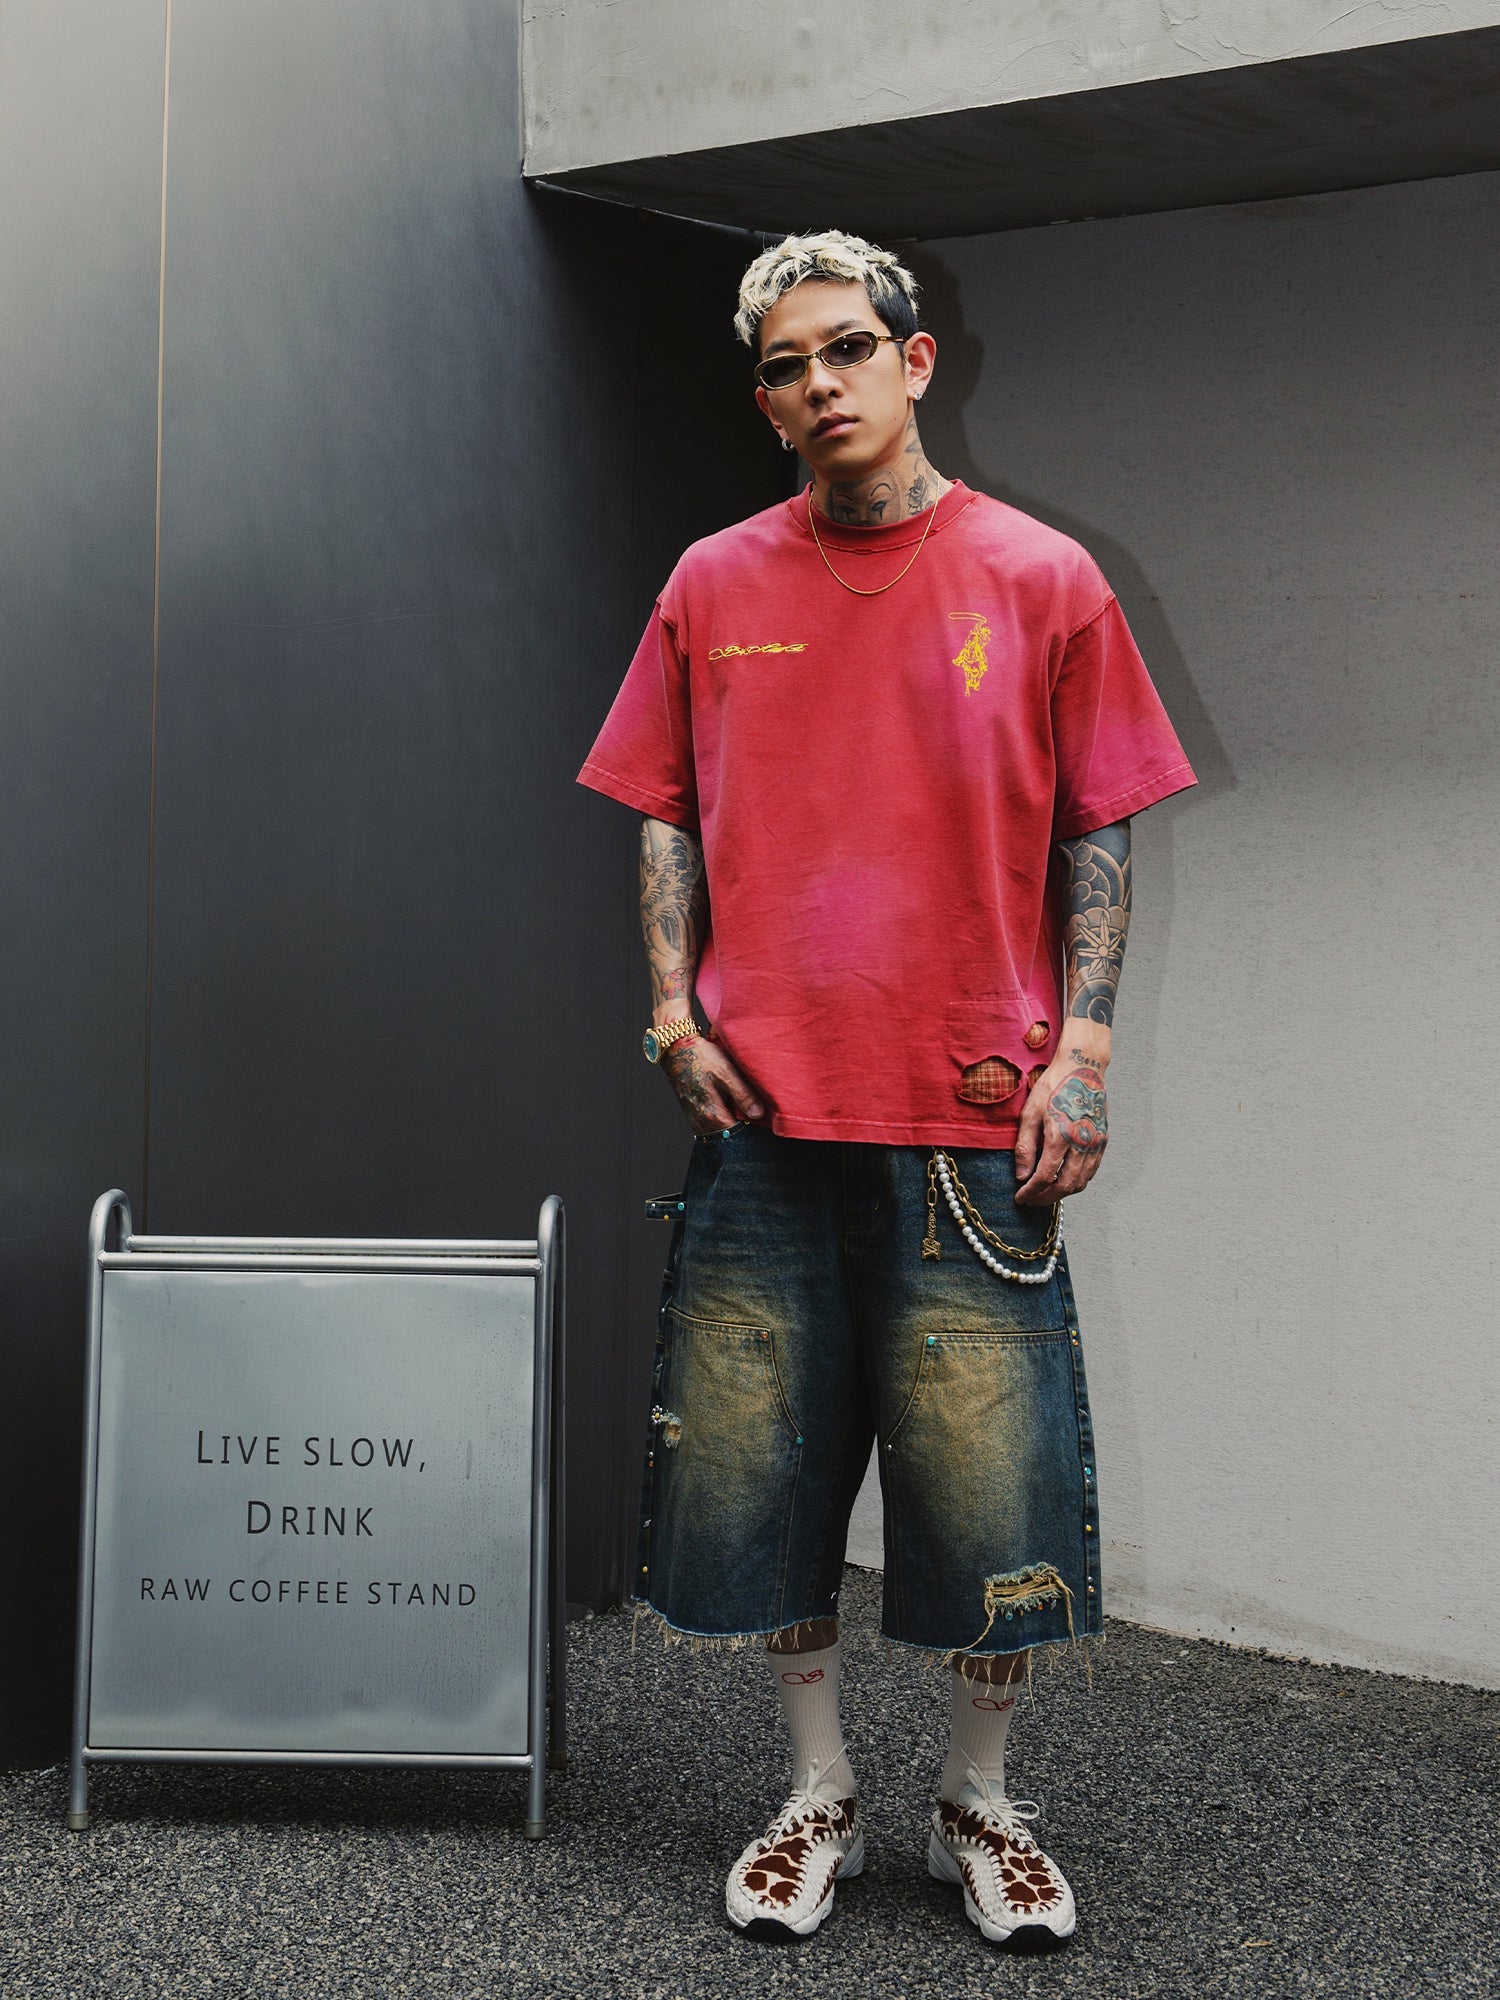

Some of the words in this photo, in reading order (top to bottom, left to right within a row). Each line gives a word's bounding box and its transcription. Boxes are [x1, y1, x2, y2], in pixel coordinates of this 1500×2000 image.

[197, 1430, 281, 1466] LIVE
[303, 1436, 427, 1473] SLOW,
[246, 1500, 374, 1537] DRINK
[140, 1577, 211, 1602] RAW
[228, 1579, 349, 1604] COFFEE
[366, 1581, 476, 1607] STAND
